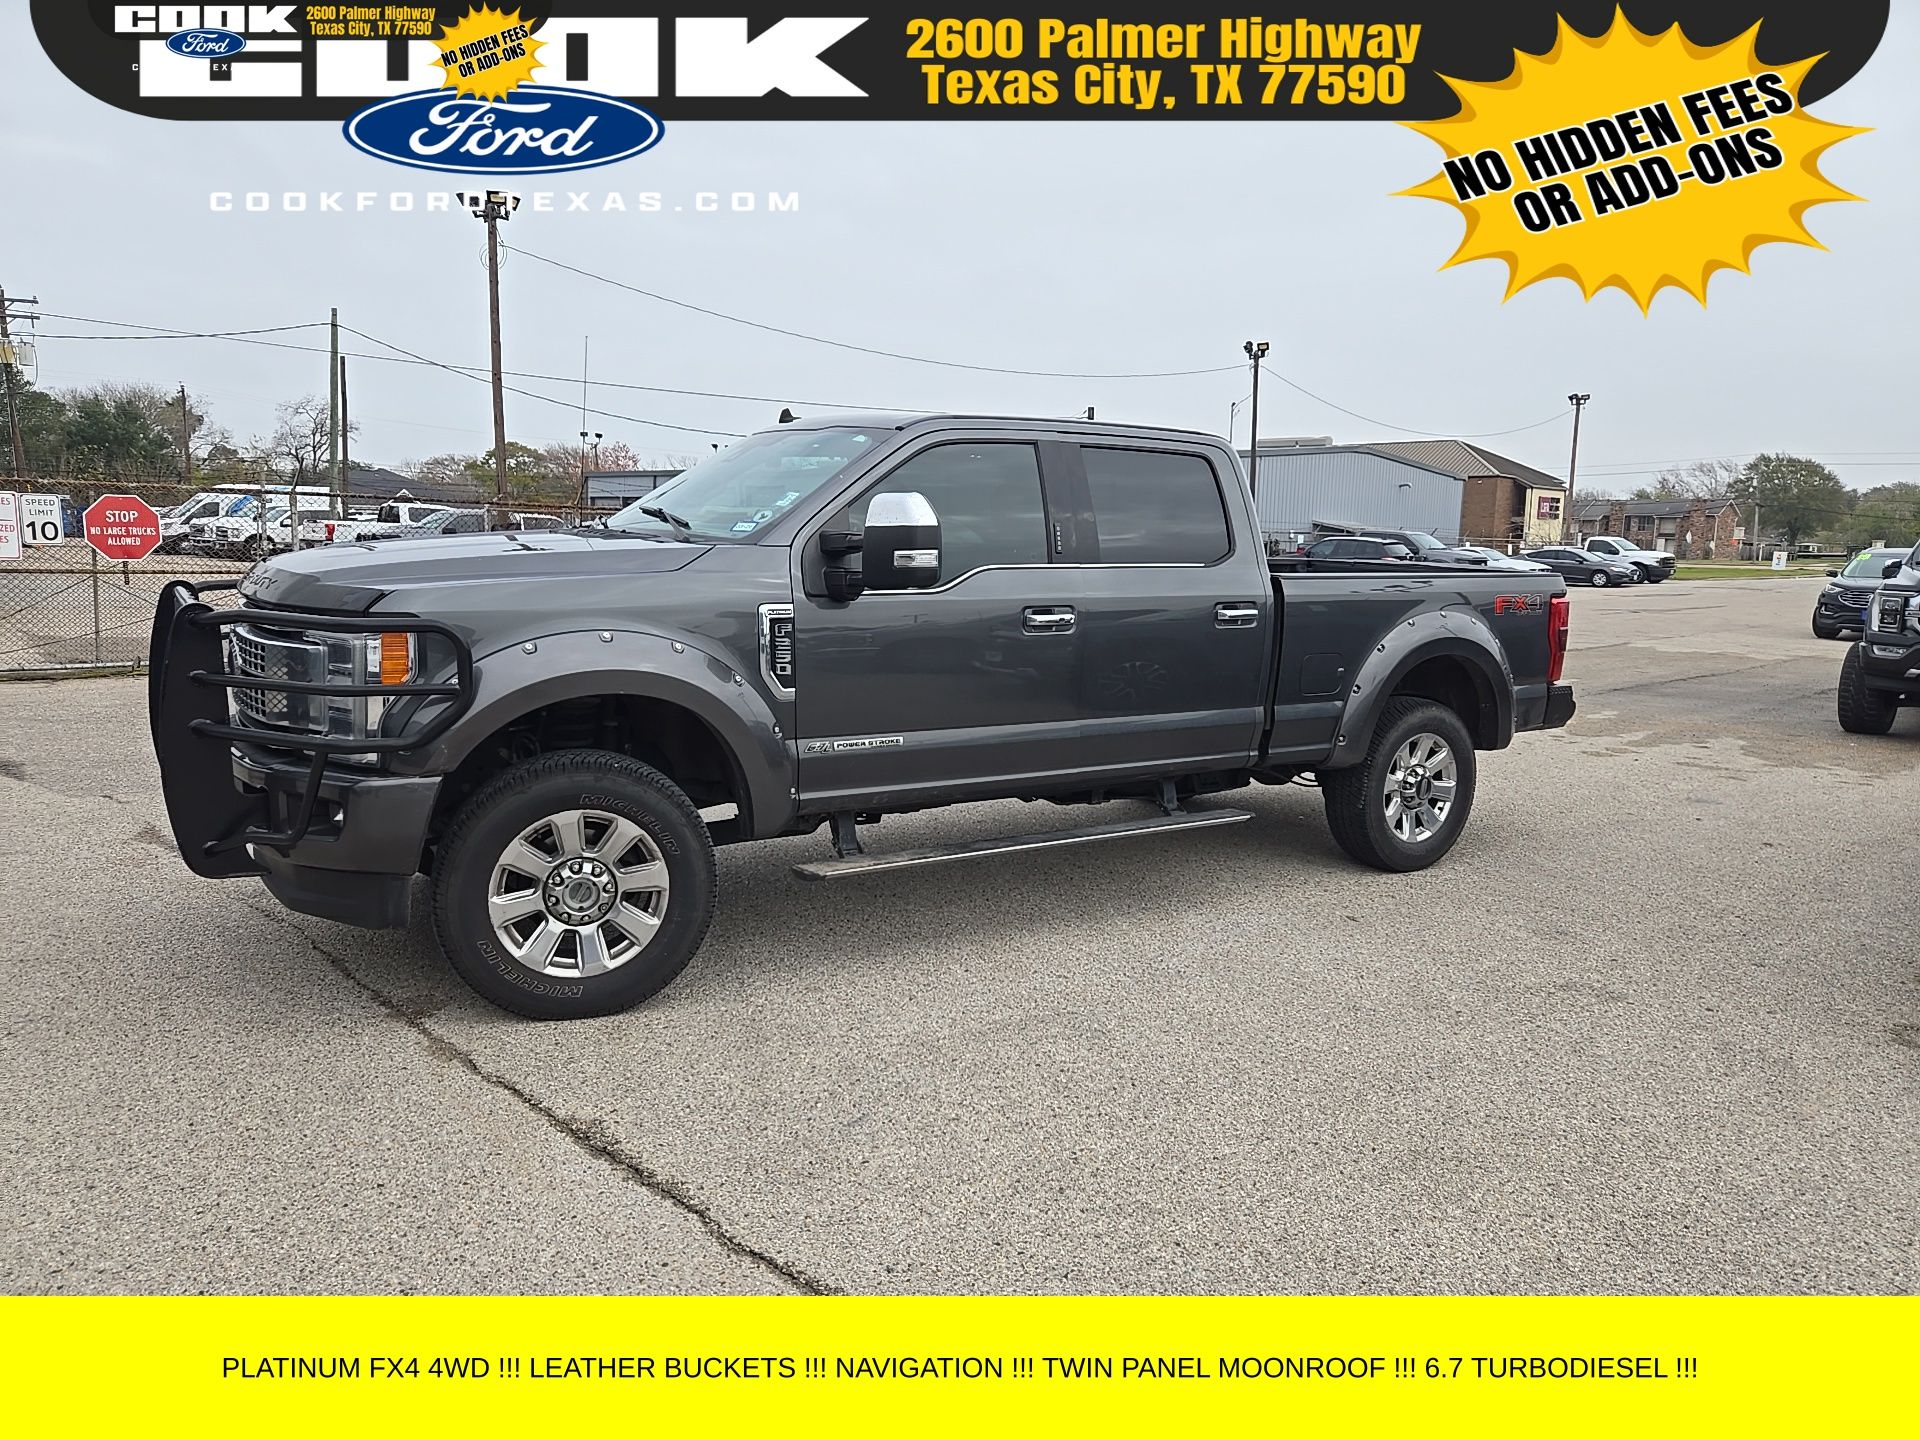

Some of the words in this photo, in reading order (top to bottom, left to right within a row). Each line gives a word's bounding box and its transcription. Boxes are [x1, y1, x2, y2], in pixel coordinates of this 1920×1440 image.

[25, 498, 55, 506] SPEED
[29, 509, 54, 517] LIMIT
[105, 510, 138, 523] STOP
[25, 521, 59, 541] 10
[90, 527, 100, 535] NO
[103, 527, 127, 535] LARGE
[129, 527, 156, 536] TRUCKS
[107, 537, 140, 546] ALLOWED
[1495, 594, 1543, 615] FX4
[836, 740, 866, 749] POWER
[868, 738, 902, 747] STROKE
[579, 793, 680, 856] MICHELIN
[476, 940, 584, 998] MICHELIN
